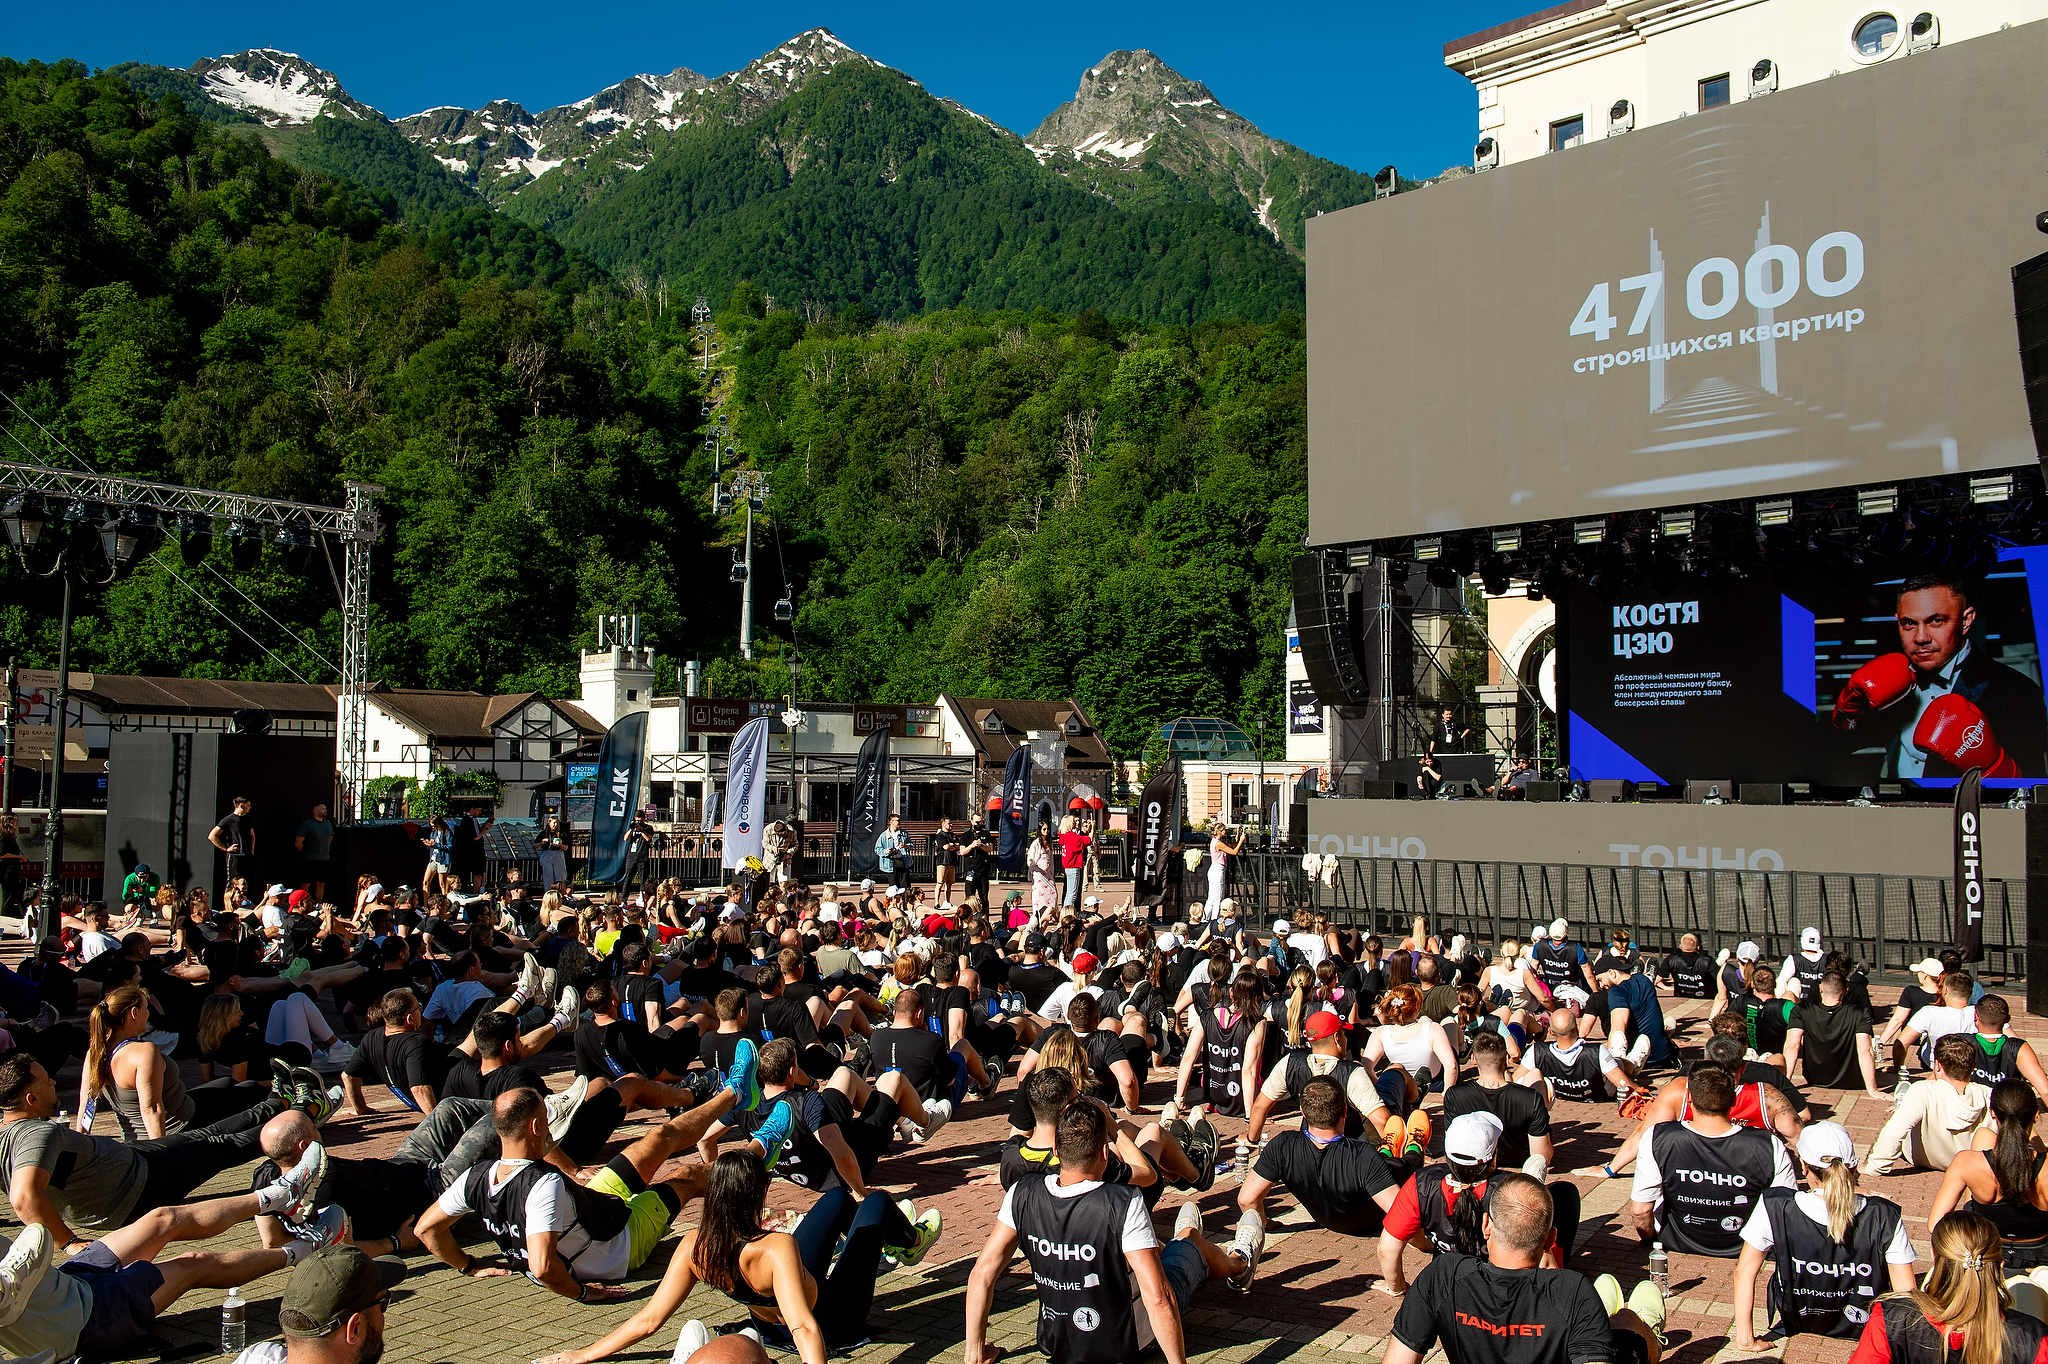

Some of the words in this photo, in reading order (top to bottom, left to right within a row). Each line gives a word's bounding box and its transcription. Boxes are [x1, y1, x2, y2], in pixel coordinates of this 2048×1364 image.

[1569, 270, 1664, 342] 47
[1686, 231, 1865, 321] 000
[1573, 331, 1733, 375] строящихся
[1739, 307, 1866, 342] квартир
[1612, 600, 1700, 628] КОСТЯ
[1613, 631, 1674, 659] ЦЗЮ
[1614, 673, 1663, 681] Абсолютный
[1664, 672, 1699, 680] чемпион
[1700, 671, 1721, 680] мира
[1625, 681, 1706, 690] профессиональному
[1706, 679, 1732, 688] боксу,
[1614, 699, 1659, 708] боксерской
[1660, 699, 1685, 707] славы
[1634, 690, 1702, 699] международного
[1702, 688, 1722, 696] зала
[713, 718, 735, 727] Strela
[740, 745, 753, 820] СОВКОМБАНК
[1143, 801, 1162, 881] ТОЧНО
[1961, 811, 1982, 926] ТОЧНО
[1549, 1076, 1589, 1089] ТОЧНО
[1675, 1169, 1747, 1188] ТОЧНО
[1677, 1194, 1732, 1207] ДВИЖЕНИЕ
[1027, 1234, 1097, 1262] ТОЧНО
[1791, 1256, 1873, 1278] ТОЧНО
[1455, 1311, 1546, 1337] ПАРИТЕТ
